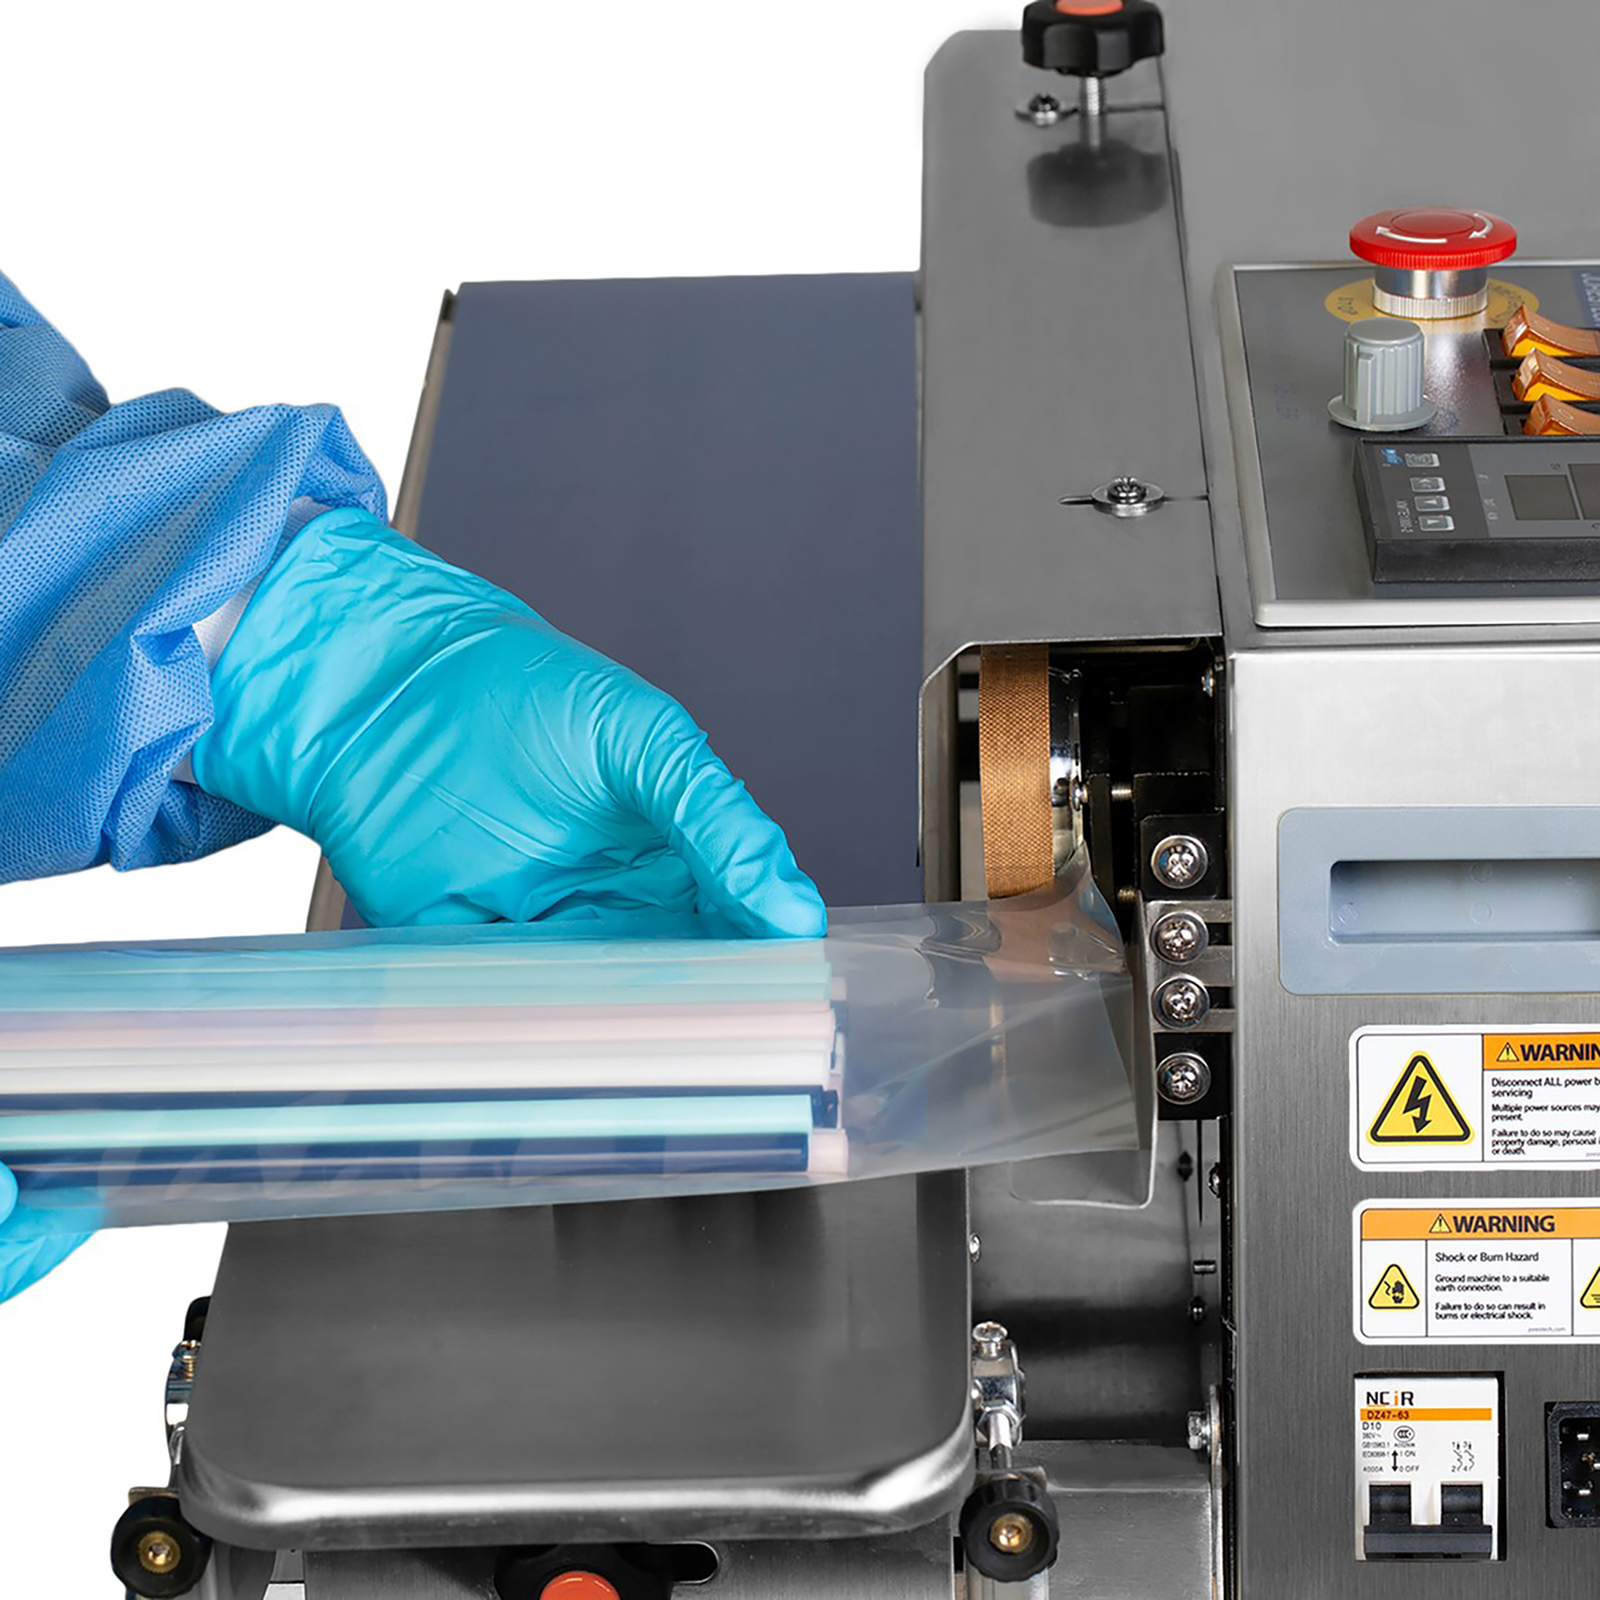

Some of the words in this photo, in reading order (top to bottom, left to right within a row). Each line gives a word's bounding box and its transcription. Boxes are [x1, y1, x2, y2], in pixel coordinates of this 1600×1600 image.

[1491, 1077, 1542, 1087] Disconnect
[1544, 1077, 1562, 1087] ALL
[1564, 1078, 1592, 1088] power
[1491, 1088, 1533, 1099] servicing
[1491, 1103, 1522, 1113] Multiple
[1524, 1104, 1549, 1113] power
[1550, 1104, 1582, 1112] sources
[1491, 1128, 1519, 1137] Failure
[1520, 1129, 1529, 1137] to
[1530, 1128, 1541, 1137] do
[1554, 1130, 1571, 1139] may
[1572, 1129, 1596, 1137] cause
[1491, 1138, 1525, 1147] property
[1526, 1138, 1560, 1148] damage,
[1562, 1137, 1597, 1147] personal
[1452, 1215, 1555, 1233] WARNING
[1435, 1252, 1465, 1262] Shock
[1467, 1254, 1478, 1262] or
[1480, 1252, 1504, 1262] Burn
[1505, 1252, 1539, 1262] Hazard
[1435, 1274, 1465, 1283] Ground
[1467, 1274, 1500, 1282] machine
[1502, 1274, 1511, 1282] to
[1519, 1274, 1550, 1282] suitable
[1435, 1284, 1455, 1292] earth
[1457, 1284, 1503, 1292] connection.
[1435, 1302, 1462, 1311] Failure
[1464, 1303, 1472, 1311] to
[1473, 1302, 1485, 1311] do
[1513, 1302, 1536, 1310] result
[1538, 1302, 1546, 1310] in
[1435, 1312, 1458, 1320] burns
[1470, 1311, 1506, 1320] electrical
[1367, 1410, 1410, 1420] DZ47-63
[1362, 1421, 1382, 1431] D10
[1405, 1465, 1419, 1473] OFF
